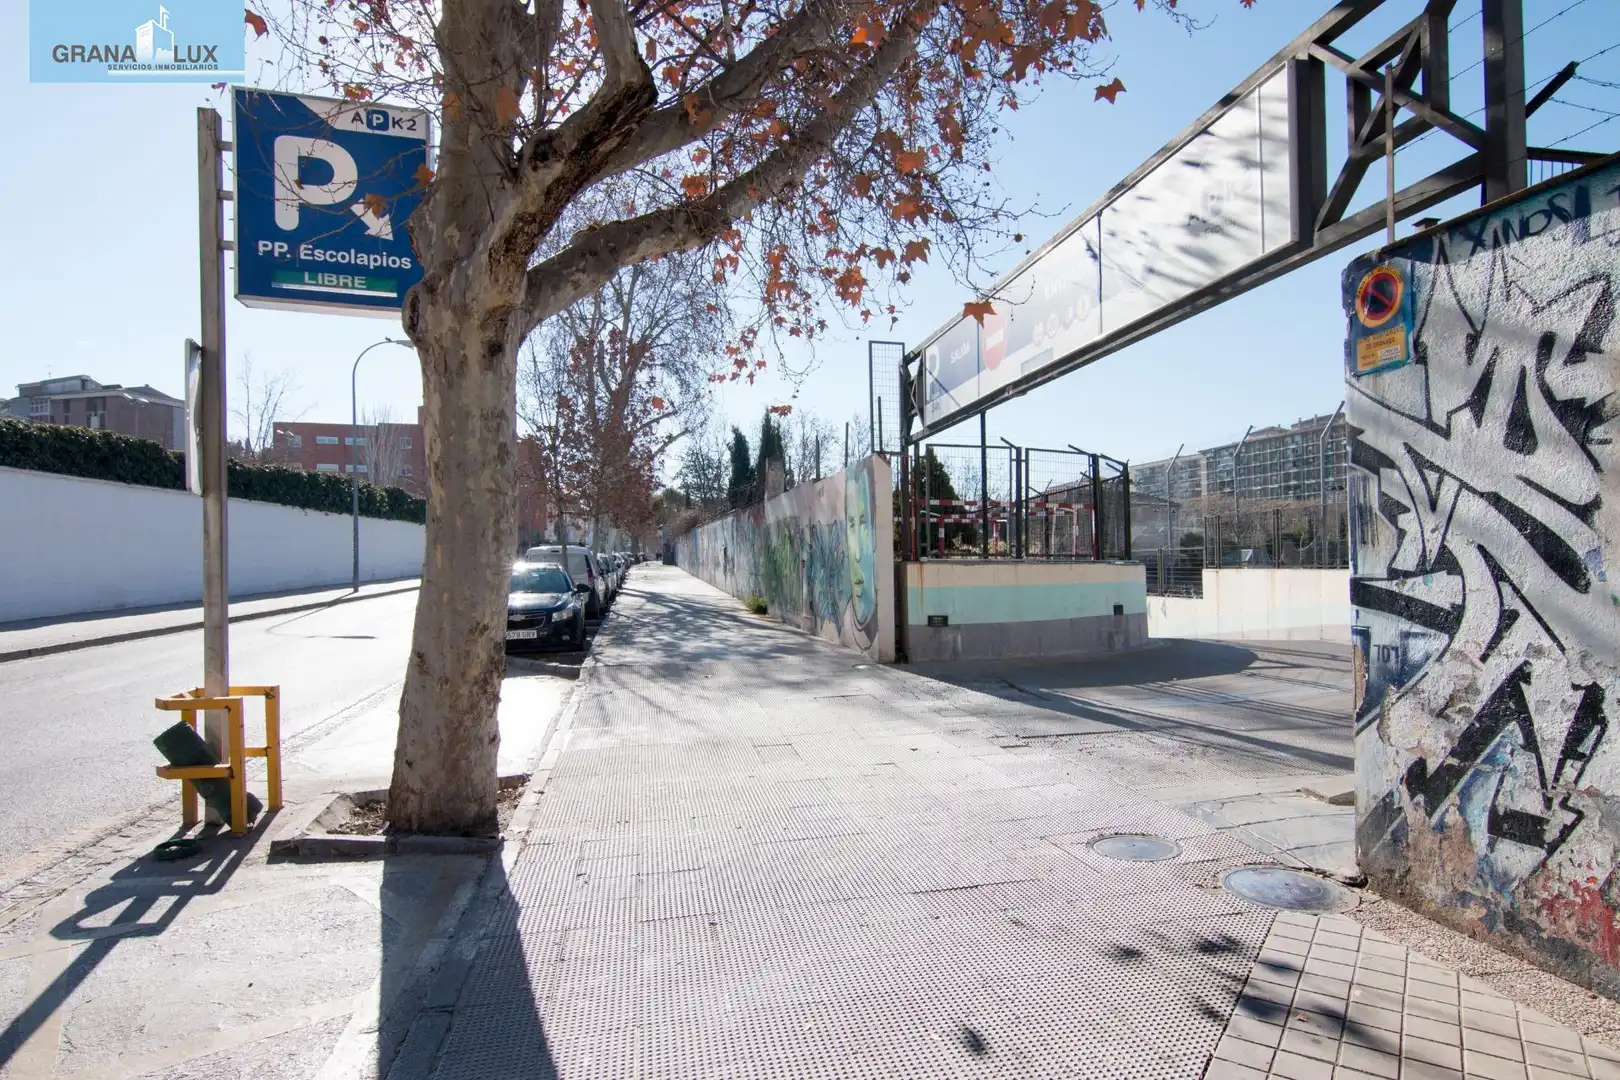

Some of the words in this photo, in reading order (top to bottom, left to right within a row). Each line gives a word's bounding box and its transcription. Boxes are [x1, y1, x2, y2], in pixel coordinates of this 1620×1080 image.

[258, 240, 291, 259] PP.
[300, 244, 412, 269] Escolapios
[303, 271, 367, 288] LIBRE
[949, 339, 971, 364] SALIDA
